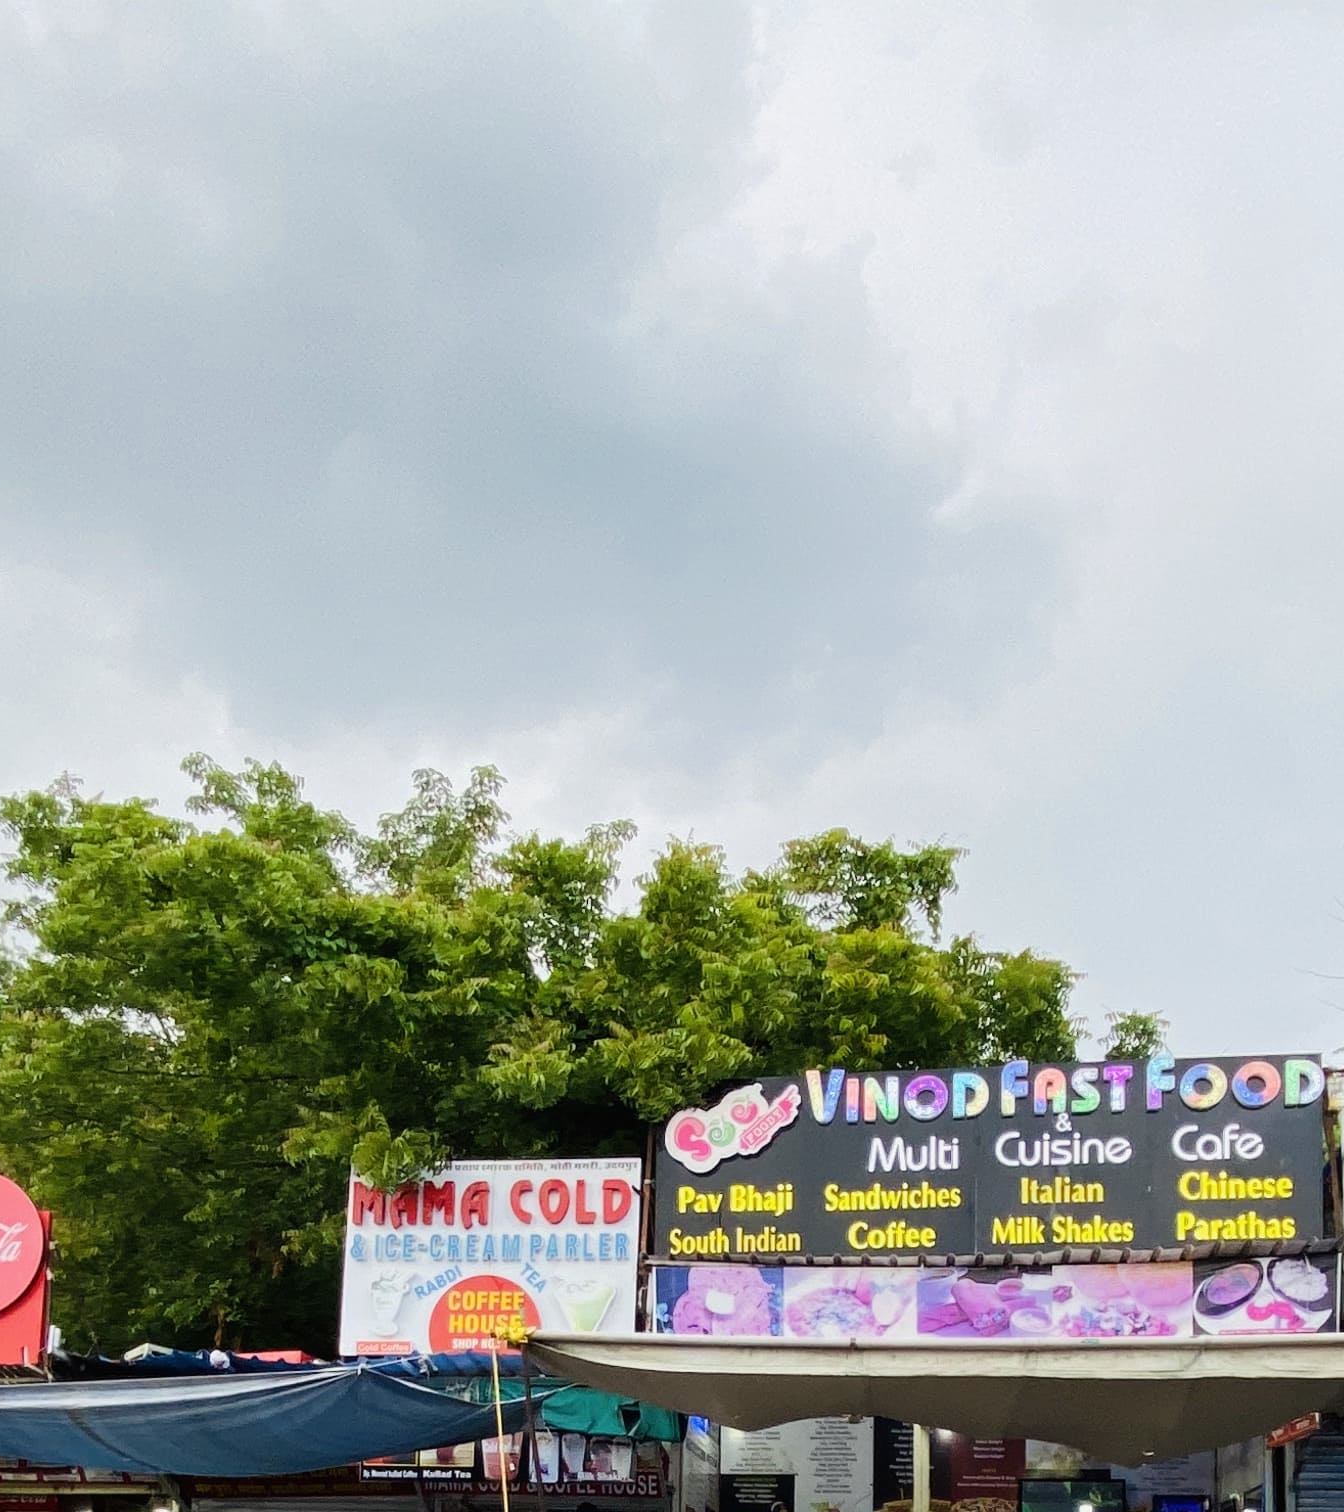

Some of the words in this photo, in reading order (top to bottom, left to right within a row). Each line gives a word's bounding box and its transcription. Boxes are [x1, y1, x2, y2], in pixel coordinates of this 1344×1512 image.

[805, 1068, 990, 1125] VINOD
[1000, 1060, 1134, 1117] FAST
[1146, 1054, 1326, 1113] FOOD
[1055, 1112, 1073, 1133] &
[867, 1135, 960, 1174] Multi
[994, 1131, 1133, 1168] Cuisine
[1171, 1122, 1265, 1162] Cafe
[677, 1185, 724, 1214] Pav
[728, 1182, 795, 1217] Bhaji
[823, 1181, 962, 1213] Sandwiches
[1019, 1176, 1105, 1205] Italian
[1178, 1170, 1295, 1201] Chinese
[352, 1180, 490, 1230] MAMA
[509, 1178, 632, 1225] COLD
[668, 1227, 730, 1256] South
[734, 1225, 802, 1253] Indian
[847, 1221, 937, 1250] Coffee
[991, 1215, 1046, 1245] Milk
[1051, 1214, 1135, 1244] Shakes
[1175, 1210, 1297, 1242] Parathas
[349, 1233, 366, 1262] &
[374, 1233, 521, 1262] ICE-CREAM
[529, 1232, 631, 1261] PARLER
[413, 1264, 464, 1300] RABDI
[519, 1261, 548, 1294] TEA
[447, 1290, 526, 1312] COFFEE
[447, 1313, 523, 1335] HOUSE
[451, 1337, 479, 1350] SHOP
